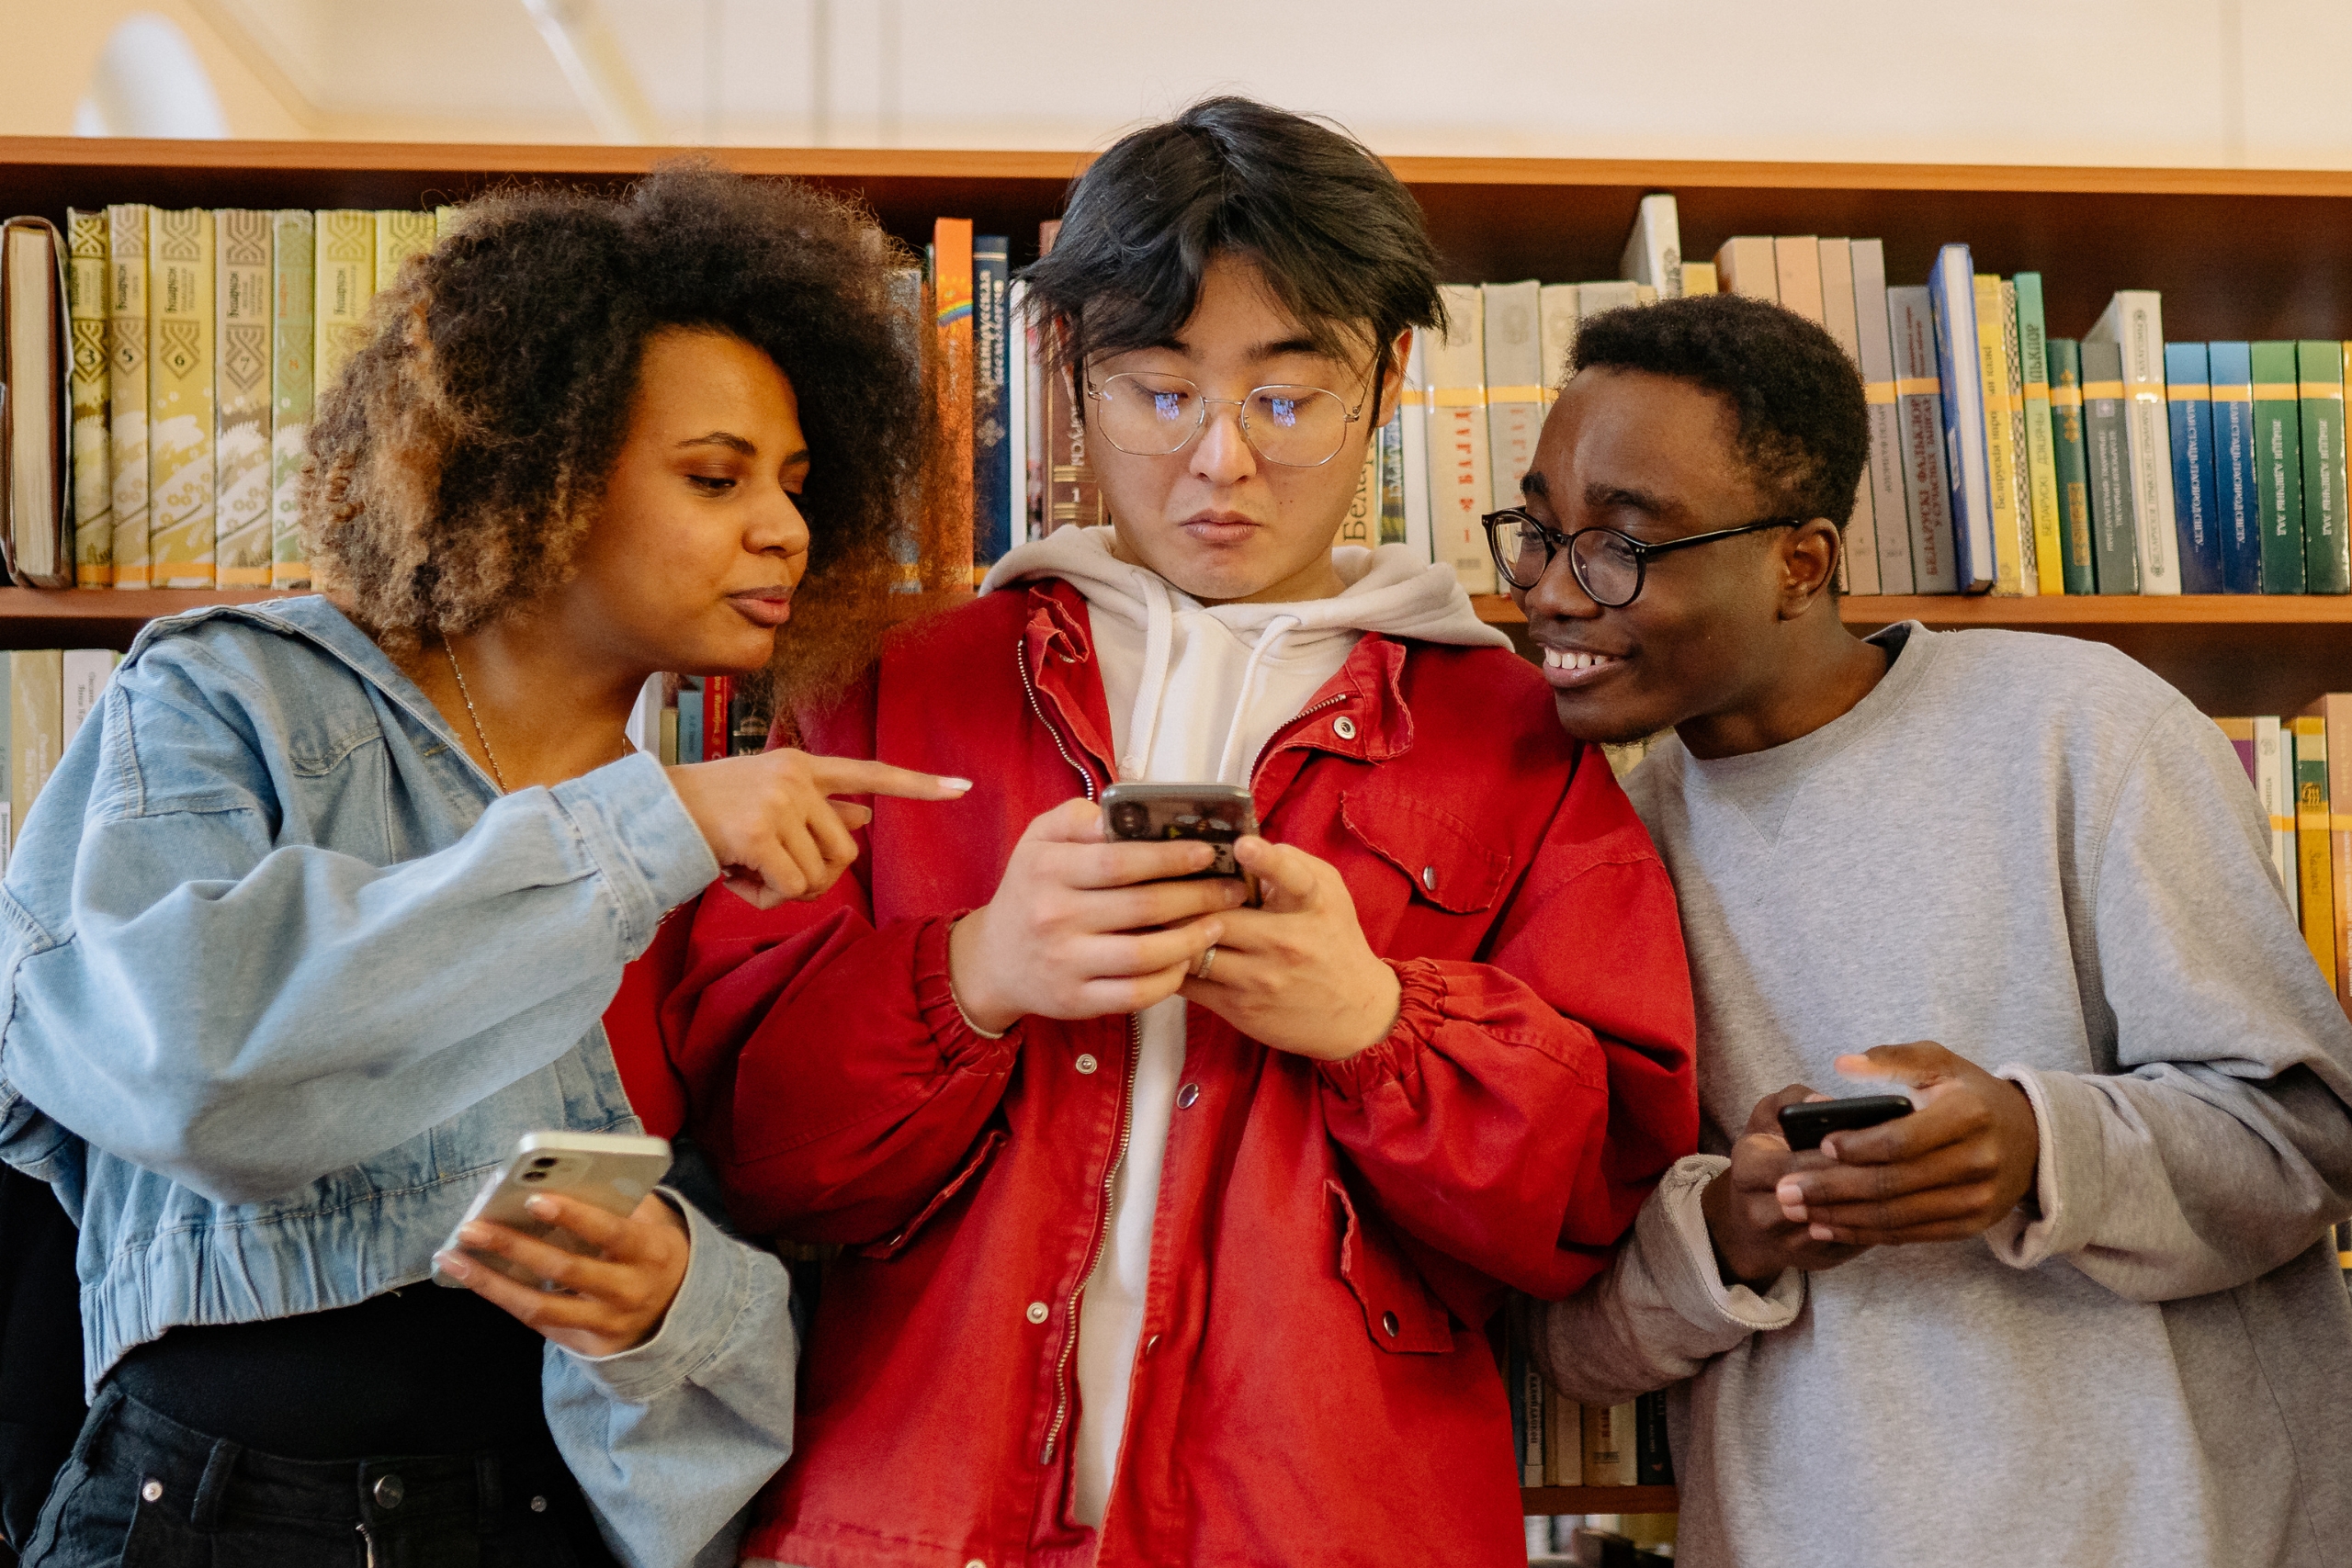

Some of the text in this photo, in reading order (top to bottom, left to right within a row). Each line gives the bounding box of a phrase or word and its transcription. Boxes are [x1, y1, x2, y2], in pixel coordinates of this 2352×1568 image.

[85, 348, 96, 365] 3
[122, 348, 133, 363] 5
[1072, 488, 1080, 502] 1
